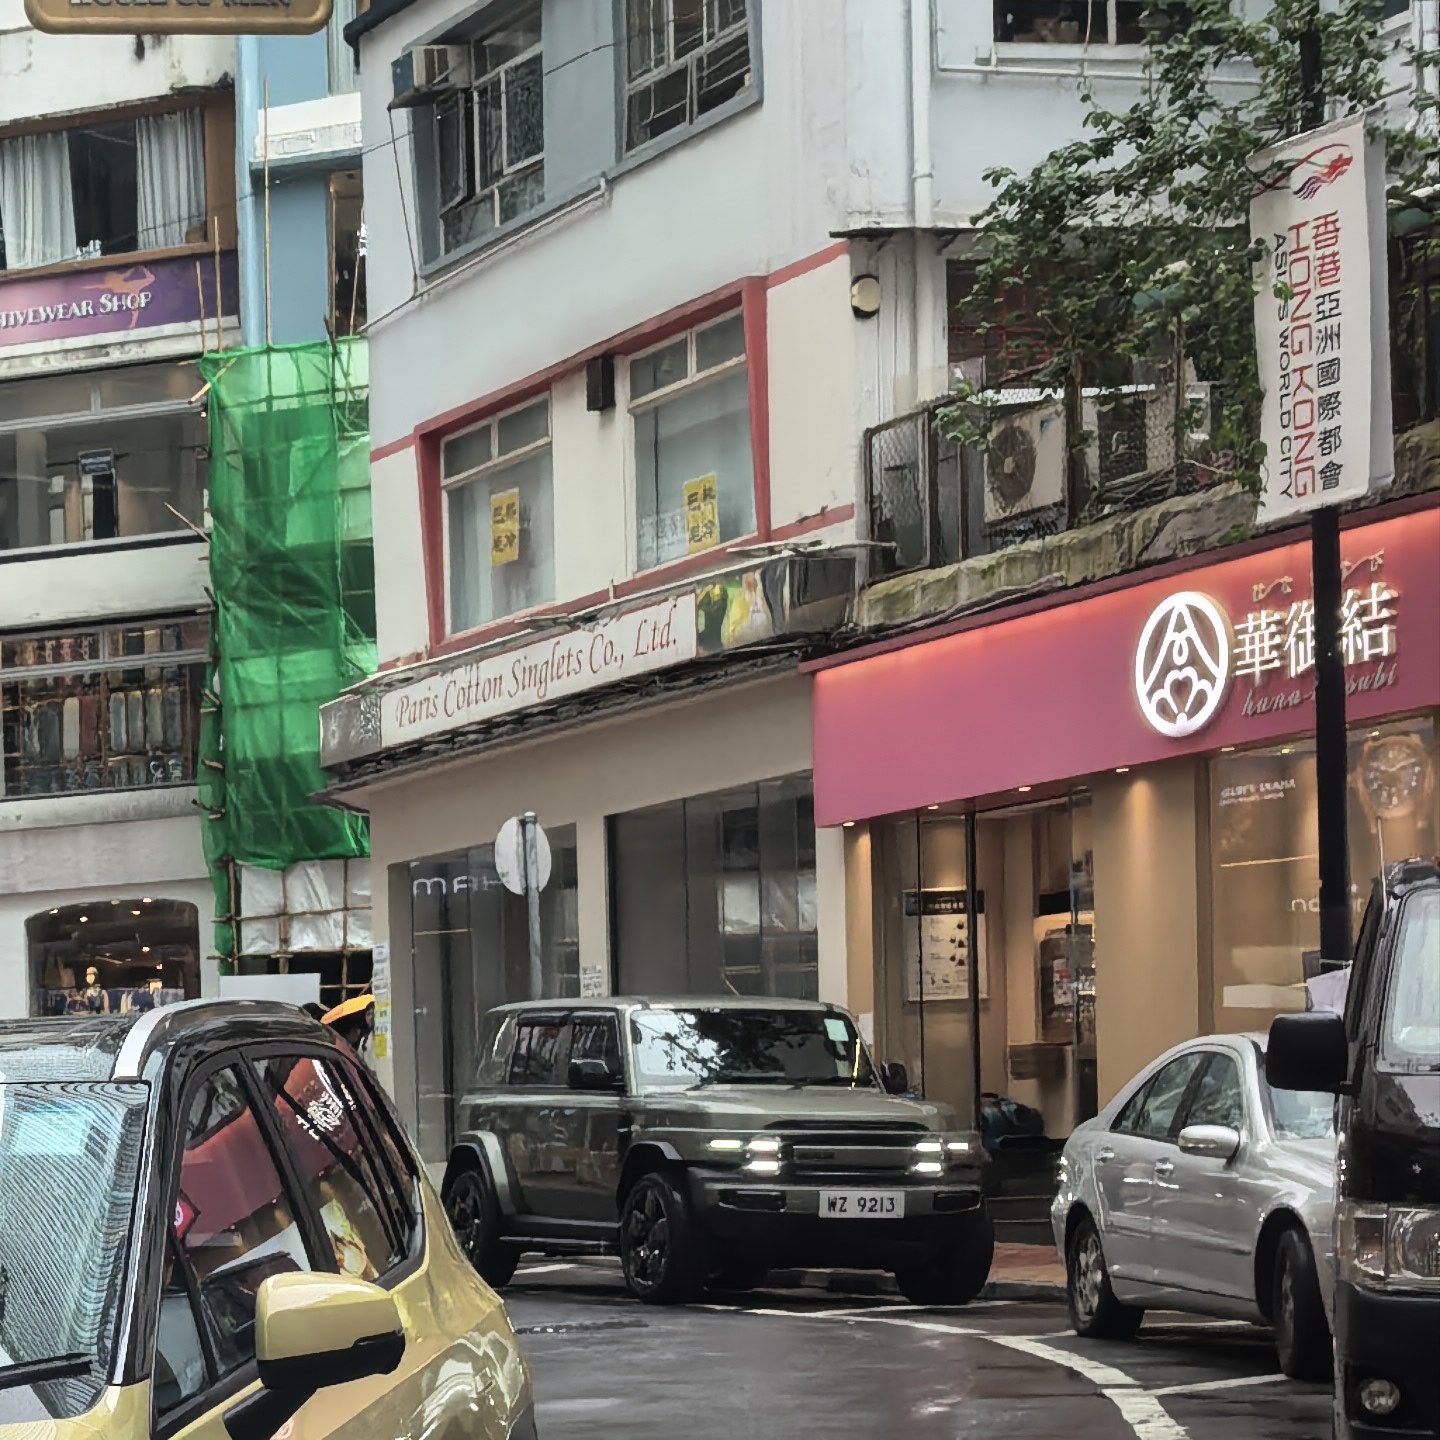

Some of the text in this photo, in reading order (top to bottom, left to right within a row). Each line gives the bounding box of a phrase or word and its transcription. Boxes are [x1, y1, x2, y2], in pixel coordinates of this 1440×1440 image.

[100, 290, 153, 316] SHOP
[1278, 326, 1292, 427] WORLD
[1287, 221, 1316, 499] HONG KONG
[1279, 436, 1294, 499] CITY
[395, 686, 438, 728] Paris
[442, 662, 503, 718] Cotton
[508, 640, 583, 699] Singlets
[588, 633, 624, 675] Co.,
[633, 604, 677, 658] Ltd.
[827, 1196, 896, 1213] WZ 9213
